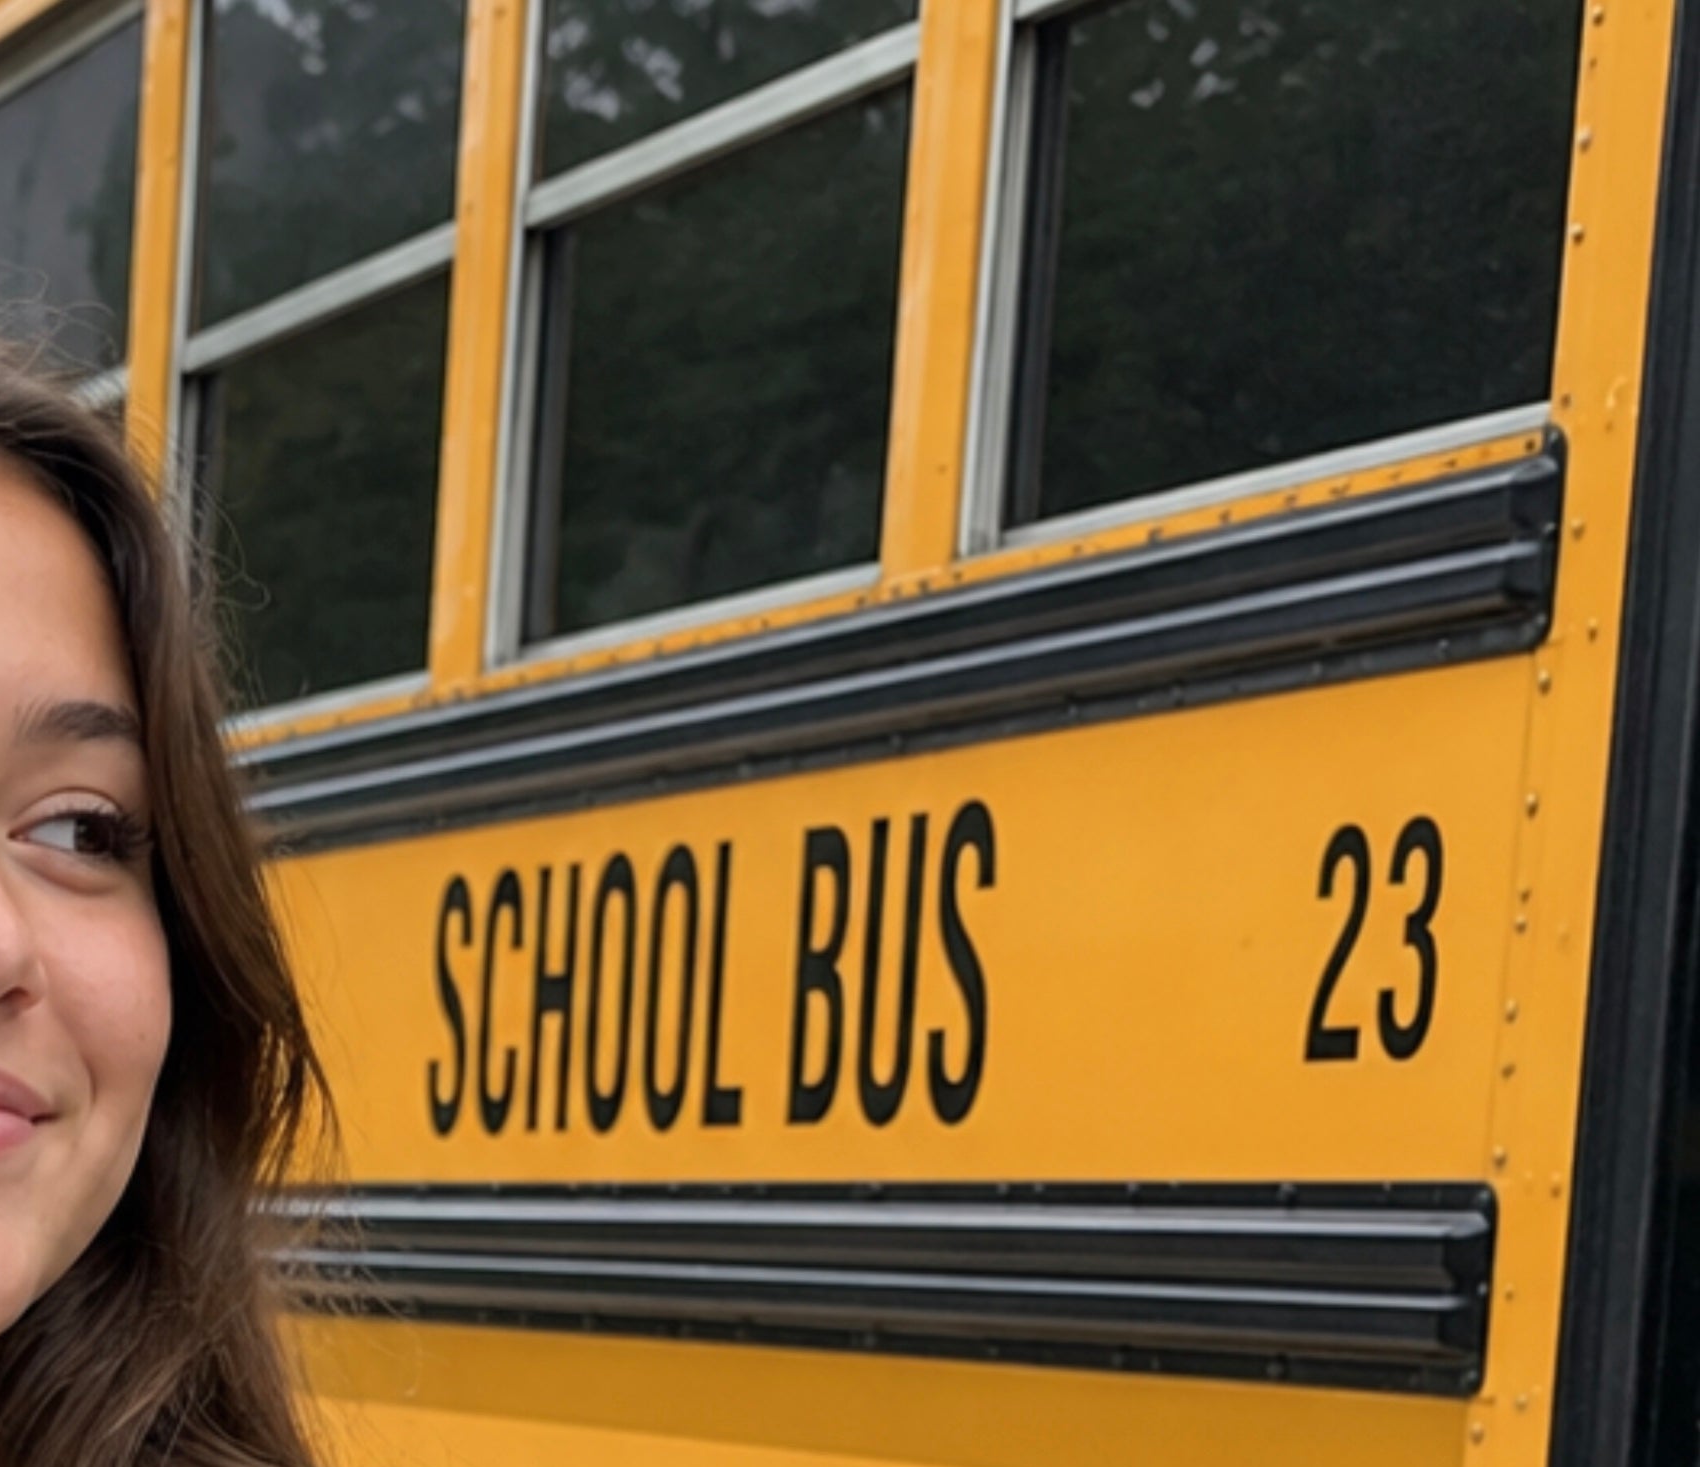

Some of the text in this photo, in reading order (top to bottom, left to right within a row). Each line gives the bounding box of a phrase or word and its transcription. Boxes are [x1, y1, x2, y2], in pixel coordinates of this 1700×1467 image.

[427, 799, 997, 1138] SCHOOL BUS
[1303, 815, 1444, 1063] 23
